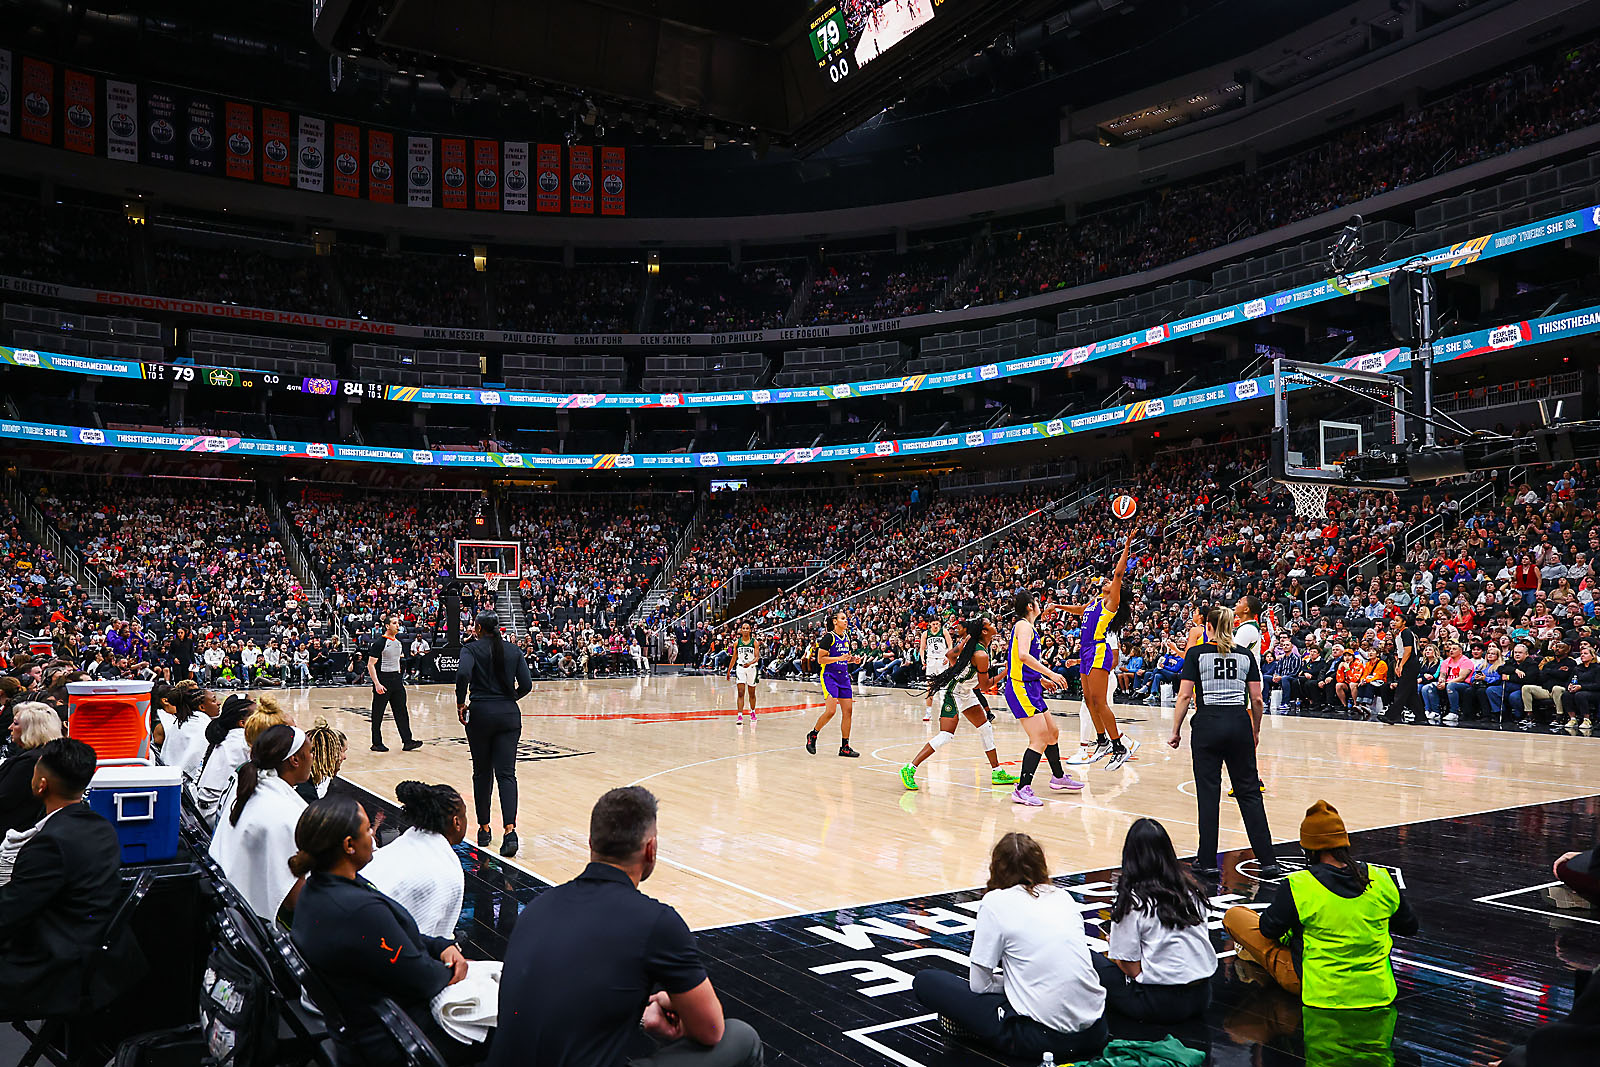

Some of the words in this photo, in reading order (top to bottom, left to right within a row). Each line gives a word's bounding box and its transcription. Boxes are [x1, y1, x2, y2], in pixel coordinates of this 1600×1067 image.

[816, 20, 840, 52] 79
[829, 57, 849, 83] 0.0
[1494, 234, 1517, 248] HOOP
[1518, 226, 1546, 242] THERE
[1546, 221, 1563, 235] SHE
[1565, 218, 1576, 230] IS.
[14, 281, 59, 297] GRETZKY
[1312, 286, 1326, 297] SHE
[96, 293, 208, 314] EDMONTON
[212, 306, 275, 321] OILERS
[279, 314, 322, 327] HALL
[325, 318, 347, 329] OF
[350, 321, 396, 335] FAME
[780, 330, 794, 339] LEE
[796, 327, 830, 338] FOGOLIN
[849, 324, 870, 335] DOUG
[871, 320, 901, 331] WEIGHT
[423, 329, 446, 338] MARK
[448, 330, 485, 340] MESSIER
[503, 333, 522, 343] PAUL
[526, 335, 557, 344] COFFEY
[711, 335, 726, 344] ROD
[728, 332, 763, 343] PHILLIPS
[1493, 327, 1518, 340] #EXPLORE
[574, 336, 598, 345] GRANT
[601, 336, 623, 345] FUHR
[640, 336, 660, 345] GLEN
[662, 336, 691, 345] SATHER
[1492, 334, 1518, 345] EDMONTON
[1445, 341, 1461, 353] SHE
[1462, 339, 1474, 350] IS.
[51, 357, 128, 373] THISISTHEGAMEEDM.COM
[1360, 360, 1383, 371] EDMONTON
[1361, 356, 1382, 366] #EXPLORE
[148, 363, 157, 372] TF
[172, 367, 195, 382] 79
[264, 375, 279, 384] 0.0
[242, 380, 253, 388] 00
[343, 383, 363, 396] 84
[368, 383, 376, 391] TF
[1206, 392, 1217, 400] SHE
[1, 423, 21, 433] HOOP
[22, 425, 44, 435] THERE
[44, 428, 58, 437] SHE
[117, 434, 194, 446] THISISTHEGAMEEDM.COM
[275, 444, 287, 452] SHE
[928, 637, 943, 646] STORM
[738, 647, 754, 655] STORM
[1213, 658, 1238, 680] 28
